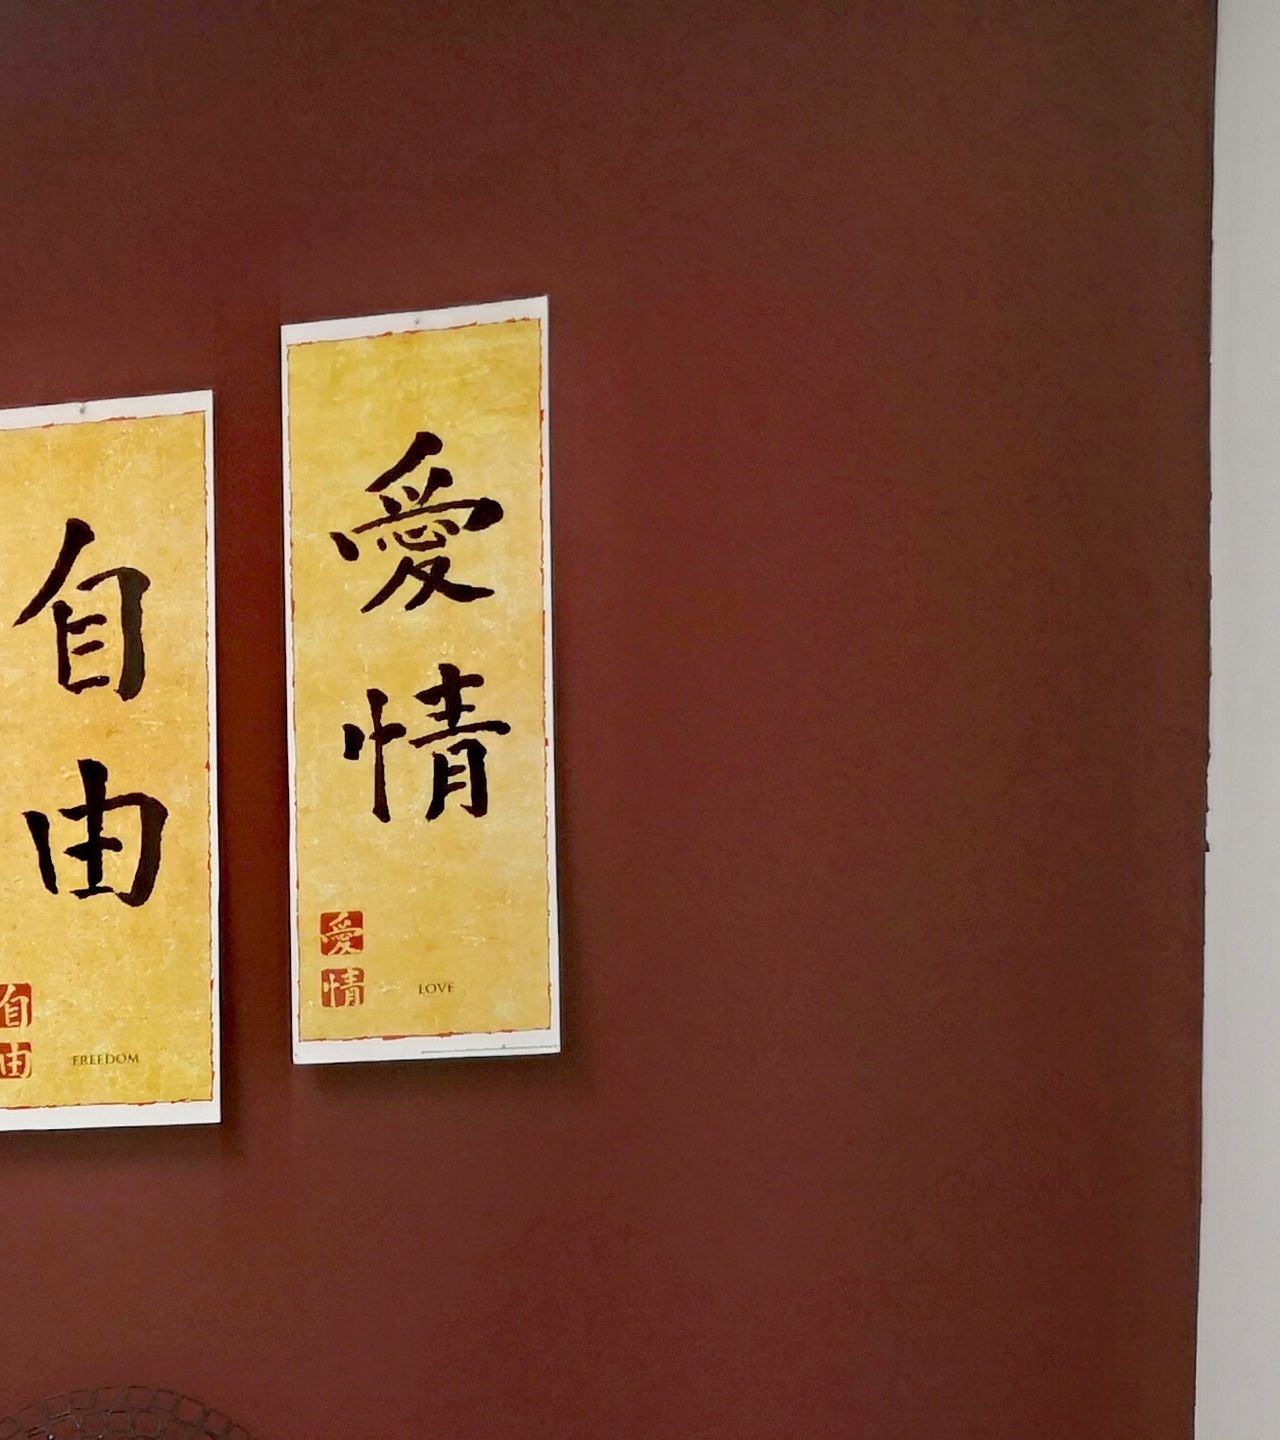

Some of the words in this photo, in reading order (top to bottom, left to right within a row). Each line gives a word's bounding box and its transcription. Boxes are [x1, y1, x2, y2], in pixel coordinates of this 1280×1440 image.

[329, 431, 511, 823] 愛情
[12, 517, 170, 908] 自由
[320, 910, 364, 1008] 愛情
[417, 982, 456, 995] LOVE
[71, 1053, 140, 1066] FREEDOM
